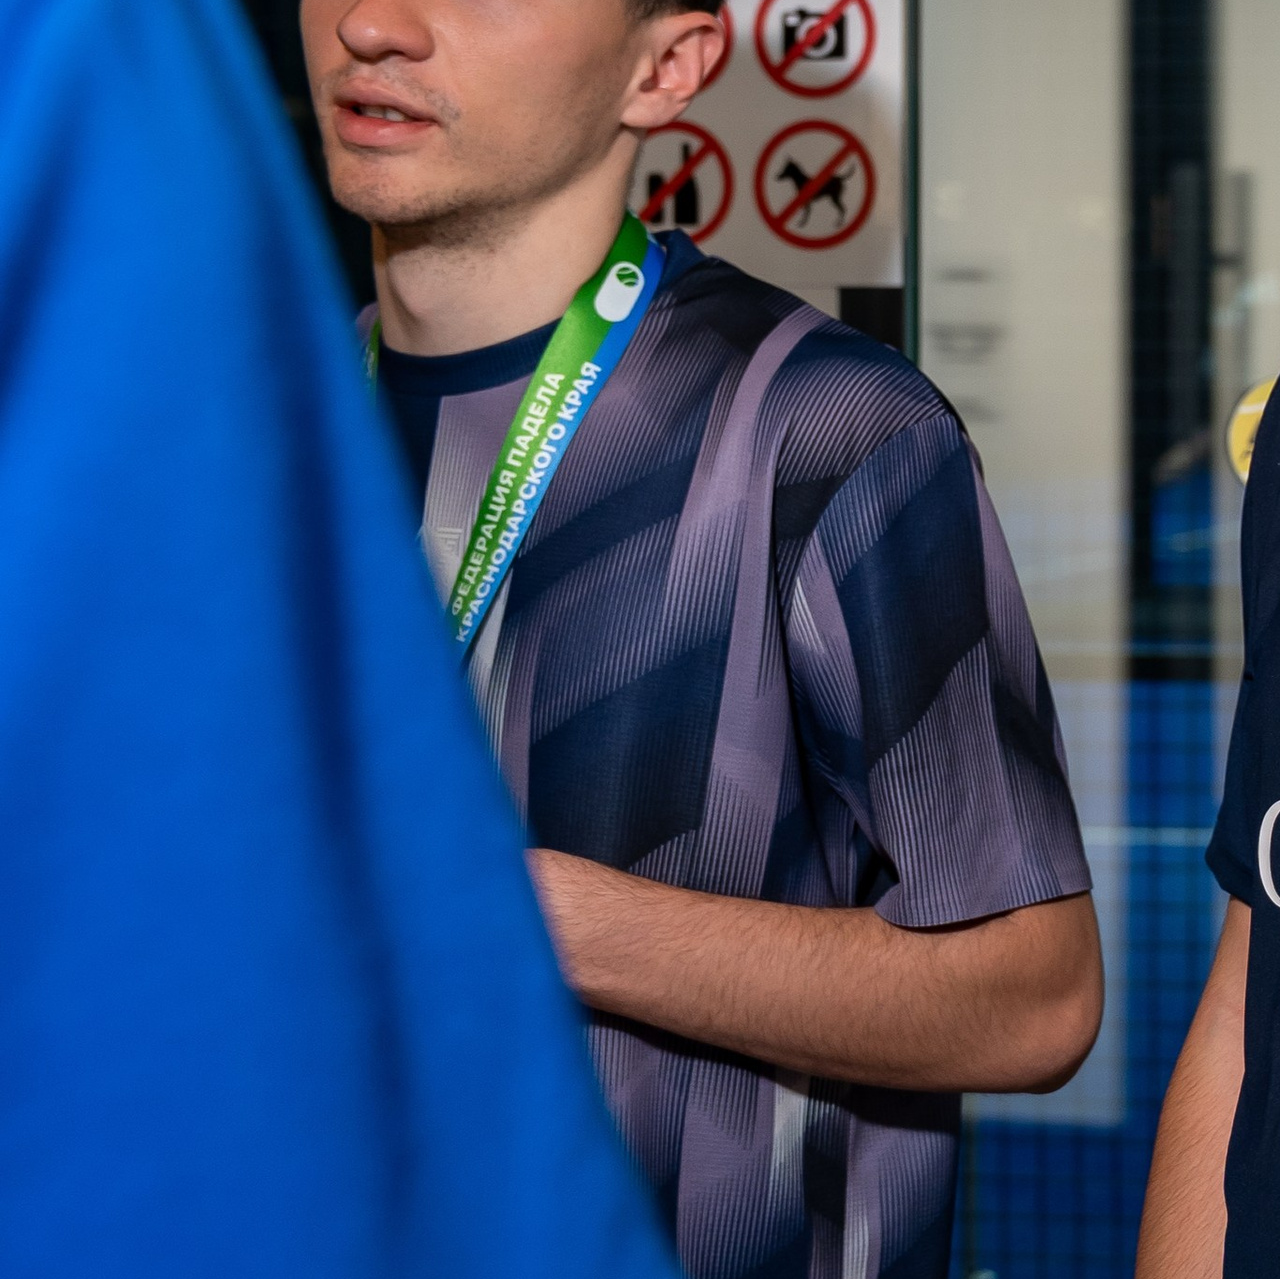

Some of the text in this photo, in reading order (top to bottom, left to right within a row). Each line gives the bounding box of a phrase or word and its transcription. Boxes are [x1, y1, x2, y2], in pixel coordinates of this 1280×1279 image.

[451, 373, 566, 616] ФЕДЕРАЦИЯ ПАДЕЛА
[455, 361, 602, 643] КРАСНОДАРСКОГО КРАЯ
